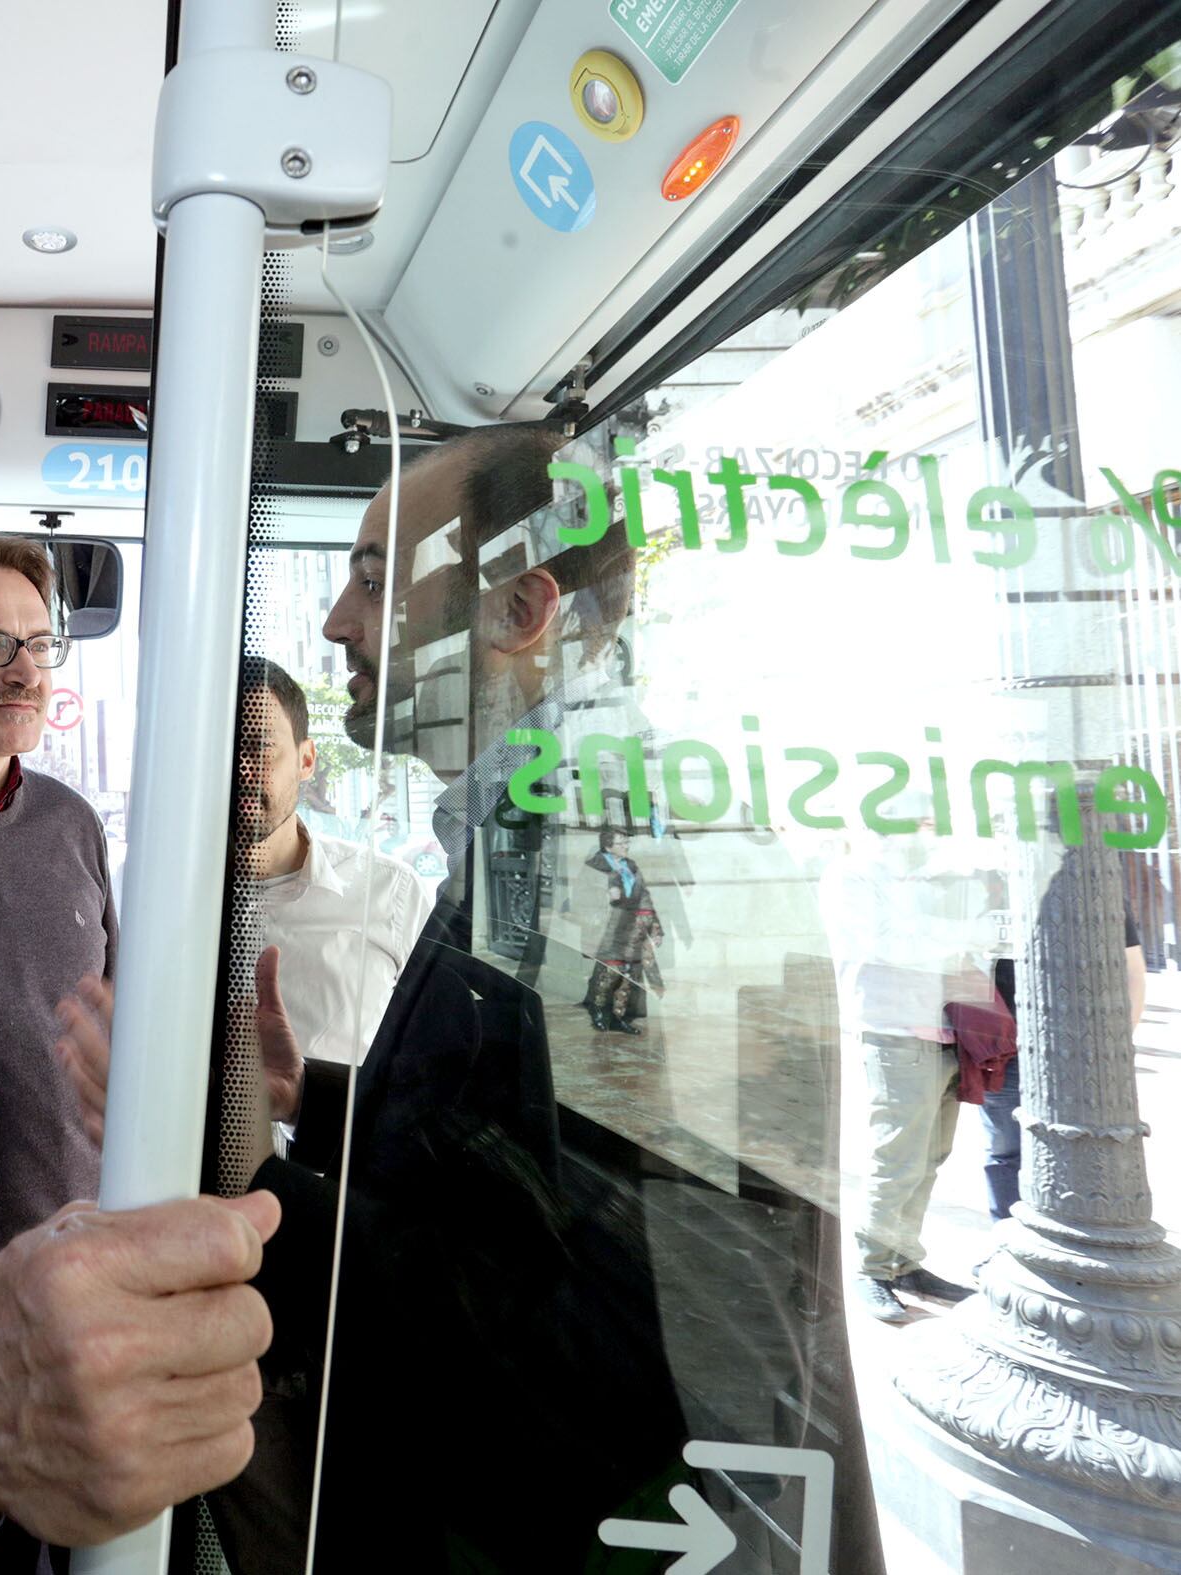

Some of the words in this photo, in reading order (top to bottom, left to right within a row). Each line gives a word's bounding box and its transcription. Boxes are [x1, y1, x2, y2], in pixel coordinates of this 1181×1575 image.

[635, 0, 667, 33] EME
[87, 331, 147, 353] RAMPA
[69, 452, 147, 491] 210
